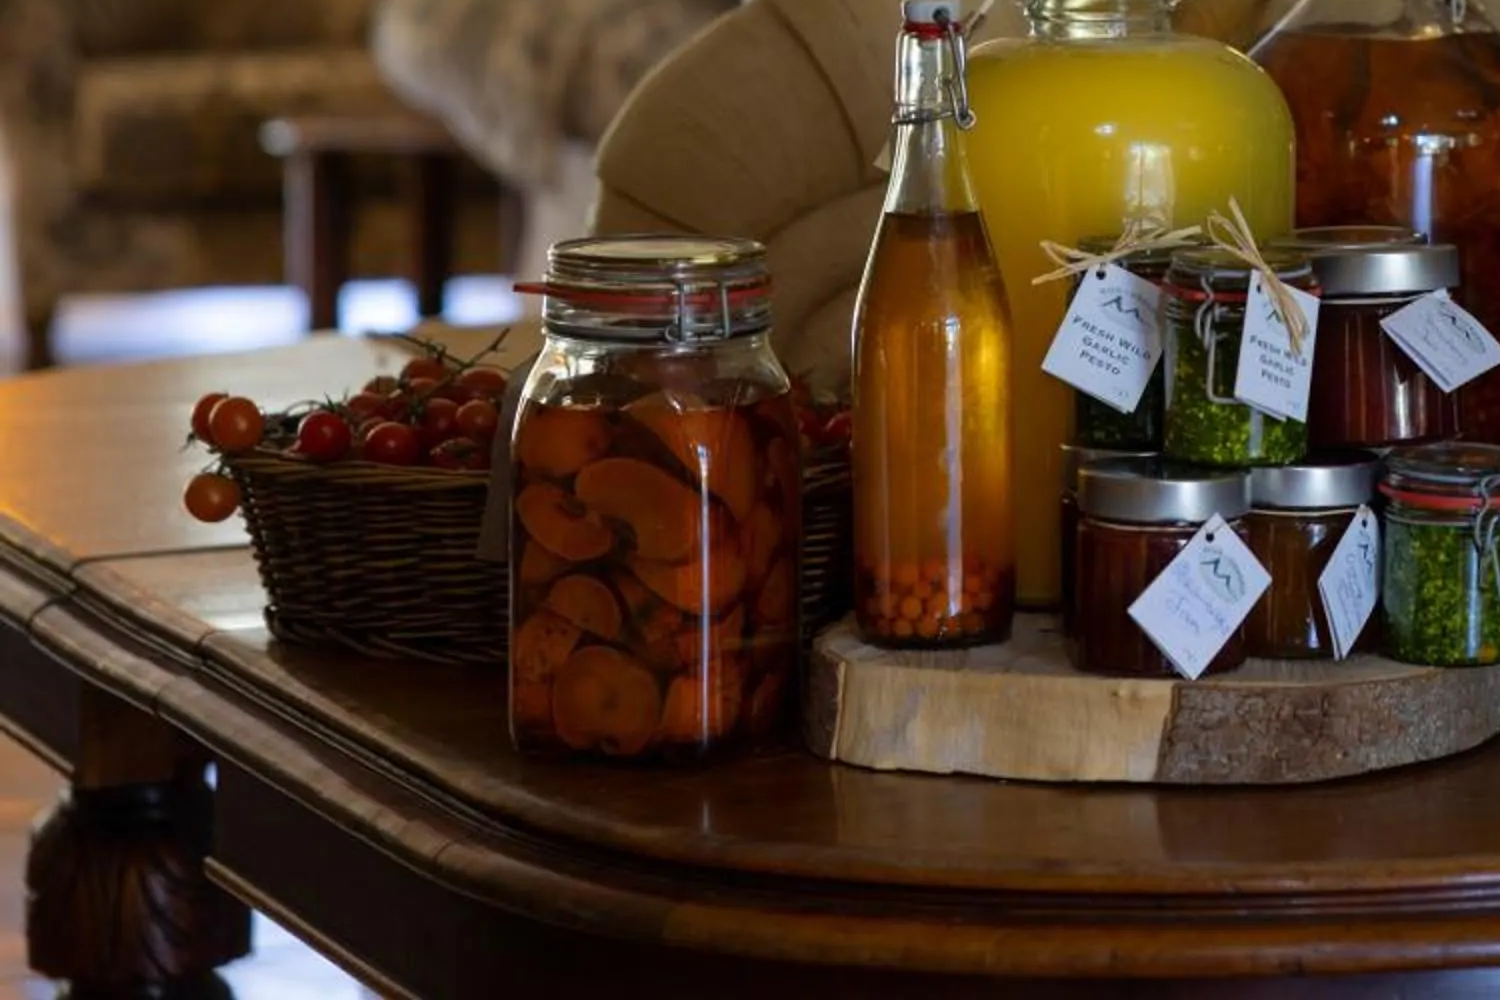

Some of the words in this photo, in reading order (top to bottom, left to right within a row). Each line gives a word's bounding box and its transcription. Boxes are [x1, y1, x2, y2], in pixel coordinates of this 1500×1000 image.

[1072, 313, 1116, 342] FRESH
[1119, 337, 1151, 361] WILD
[1082, 336, 1131, 366] GARLIC
[1079, 350, 1121, 376] PESTO
